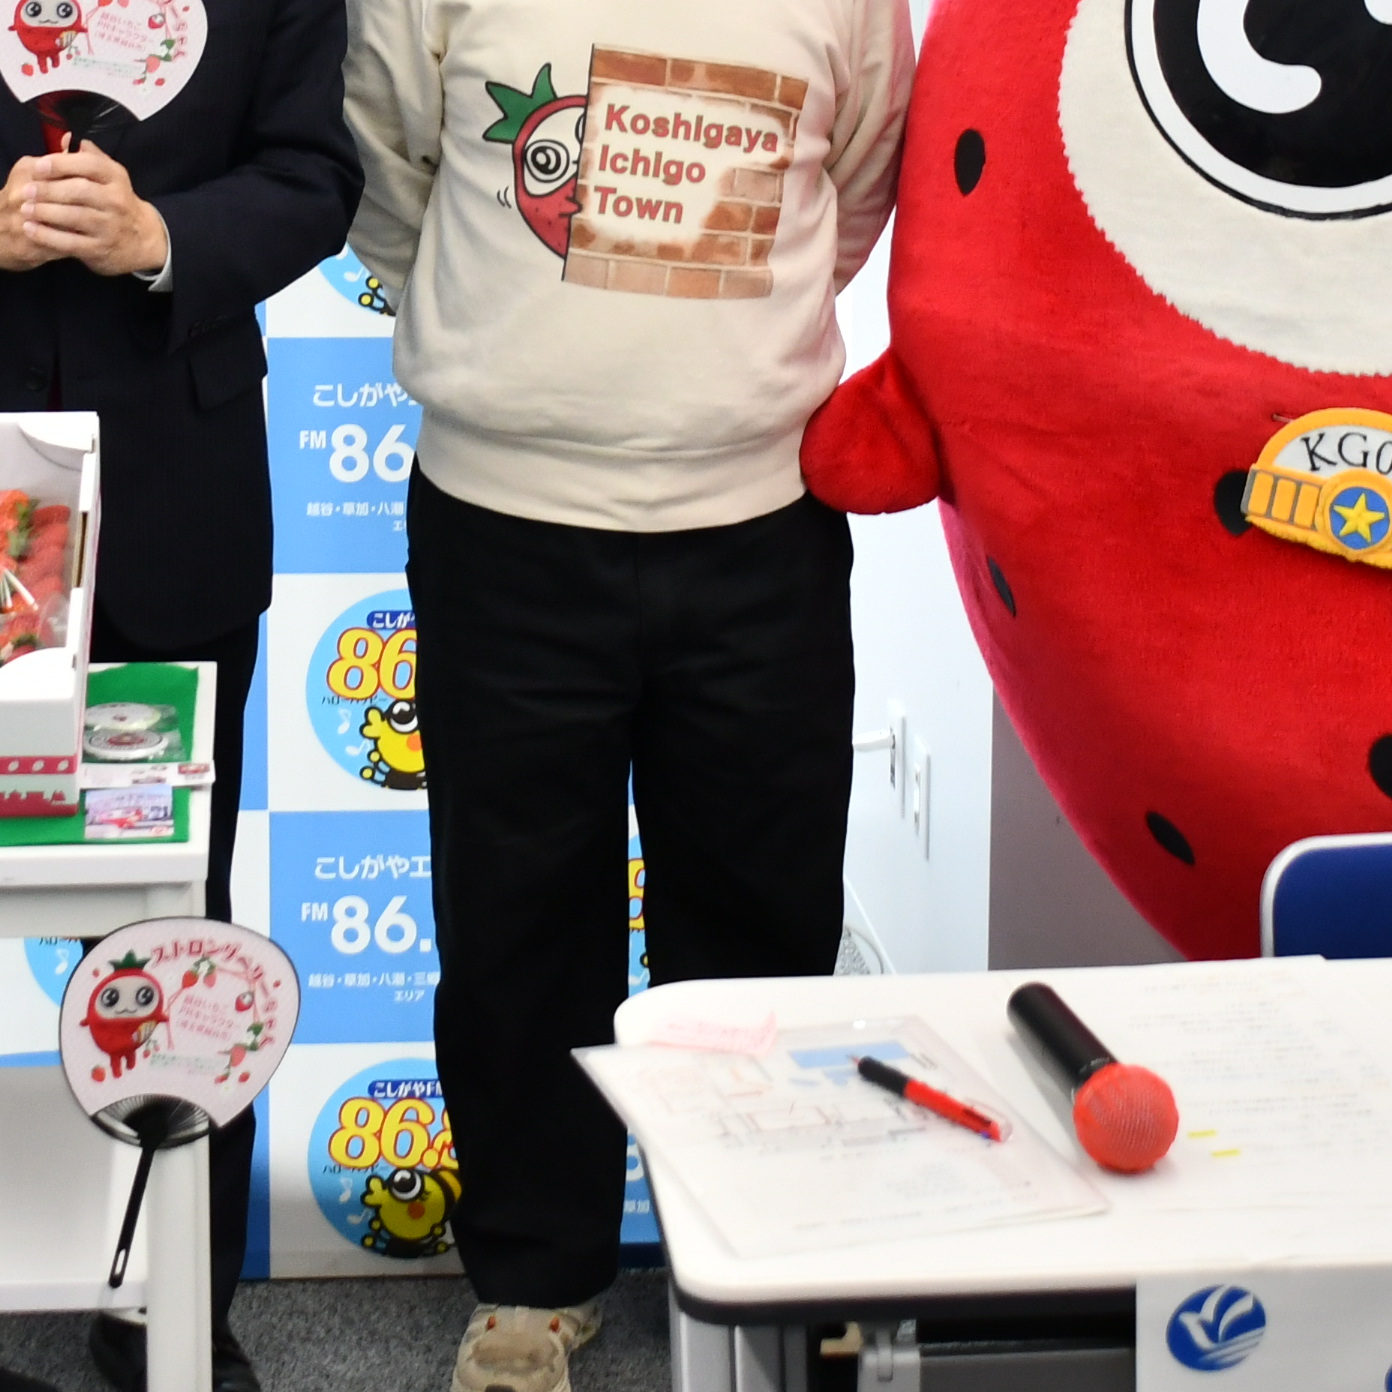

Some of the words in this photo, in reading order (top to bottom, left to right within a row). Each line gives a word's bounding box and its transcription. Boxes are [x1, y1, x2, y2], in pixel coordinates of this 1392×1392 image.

[604, 102, 779, 154] Koshigaya
[598, 144, 706, 185] Ichigo
[593, 186, 684, 224] Town
[313, 382, 418, 408] こしがや
[299, 429, 327, 450] FM
[300, 902, 329, 921] FM
[393, 989, 426, 1002] エリア
